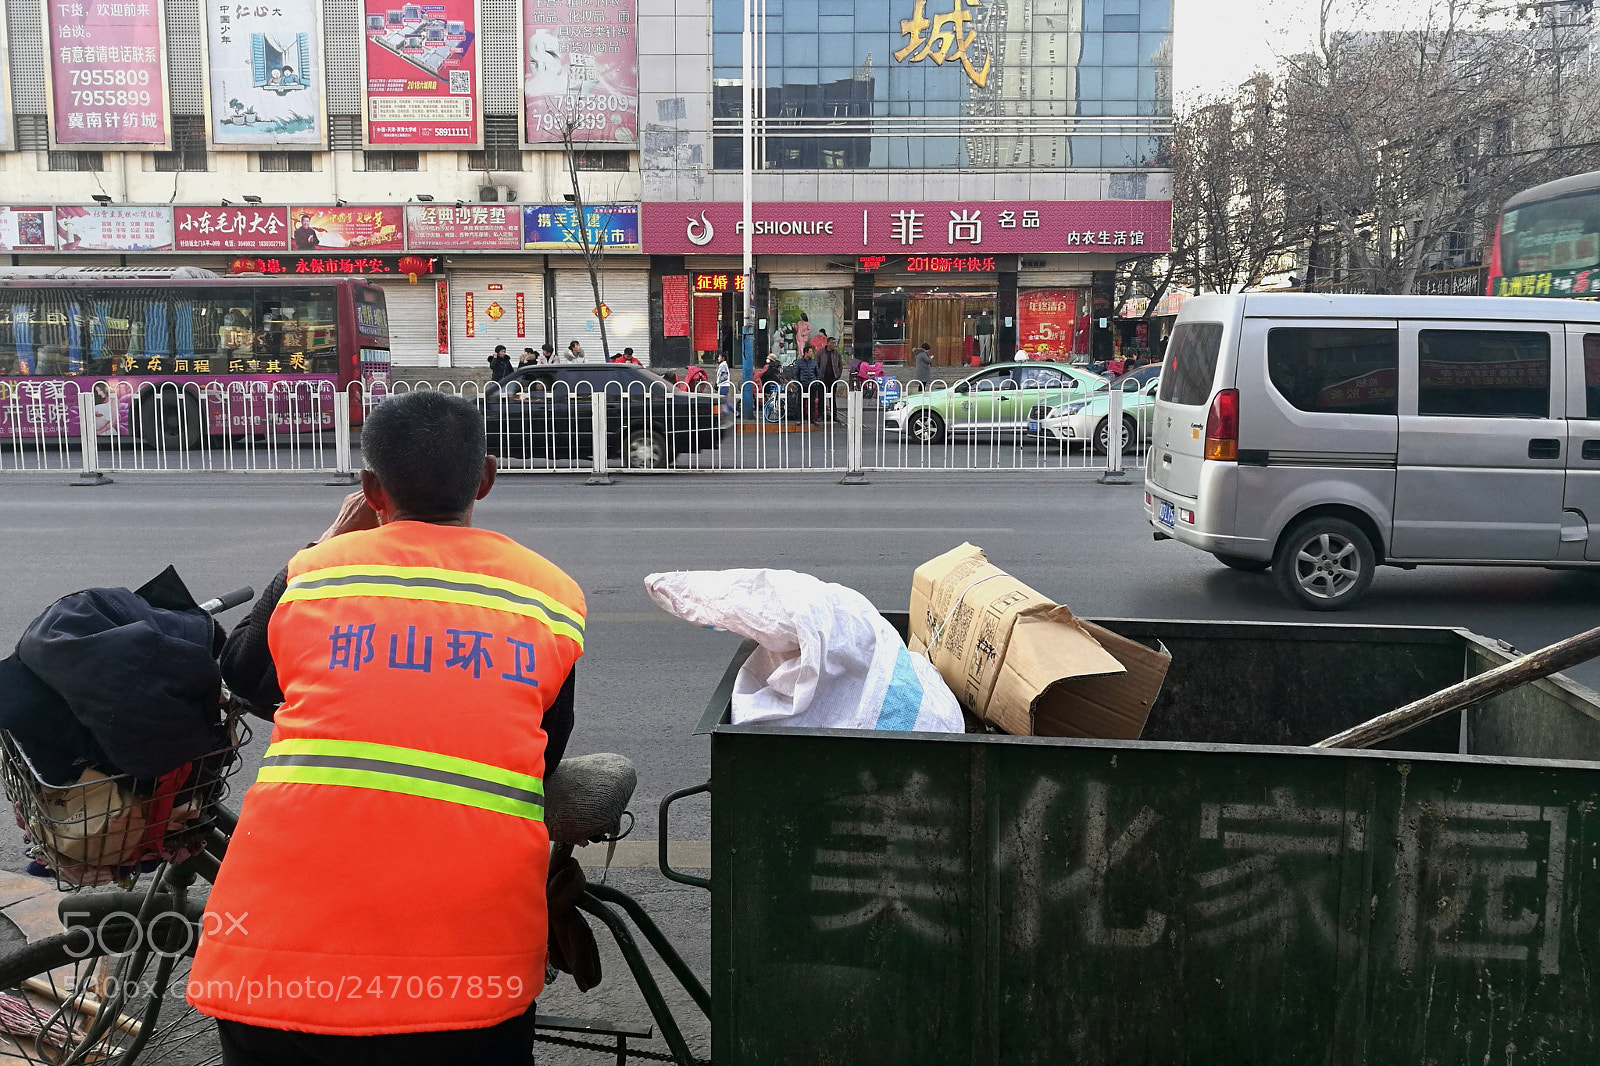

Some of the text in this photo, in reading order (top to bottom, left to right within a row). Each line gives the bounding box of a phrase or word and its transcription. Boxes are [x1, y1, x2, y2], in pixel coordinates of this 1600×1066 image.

[893, 0, 990, 87] 城
[60, 45, 158, 64] 有意者请电话联系
[70, 69, 149, 86] 7955809
[71, 90, 151, 106] 7955899
[67, 111, 158, 130] 冀南针纺城
[179, 211, 285, 235] 小东毛巾大全
[421, 207, 506, 224] 经典沙发垫
[735, 221, 833, 235] FSHIONLIFE
[890, 209, 1040, 245] 菲尚 名品
[1067, 230, 1144, 246] 内衣生活馆
[906, 256, 995, 272] 2018新年快乐
[696, 274, 728, 290] 征婚
[328, 623, 539, 688] 邯山环卫
[811, 769, 1570, 973] 美化家园
